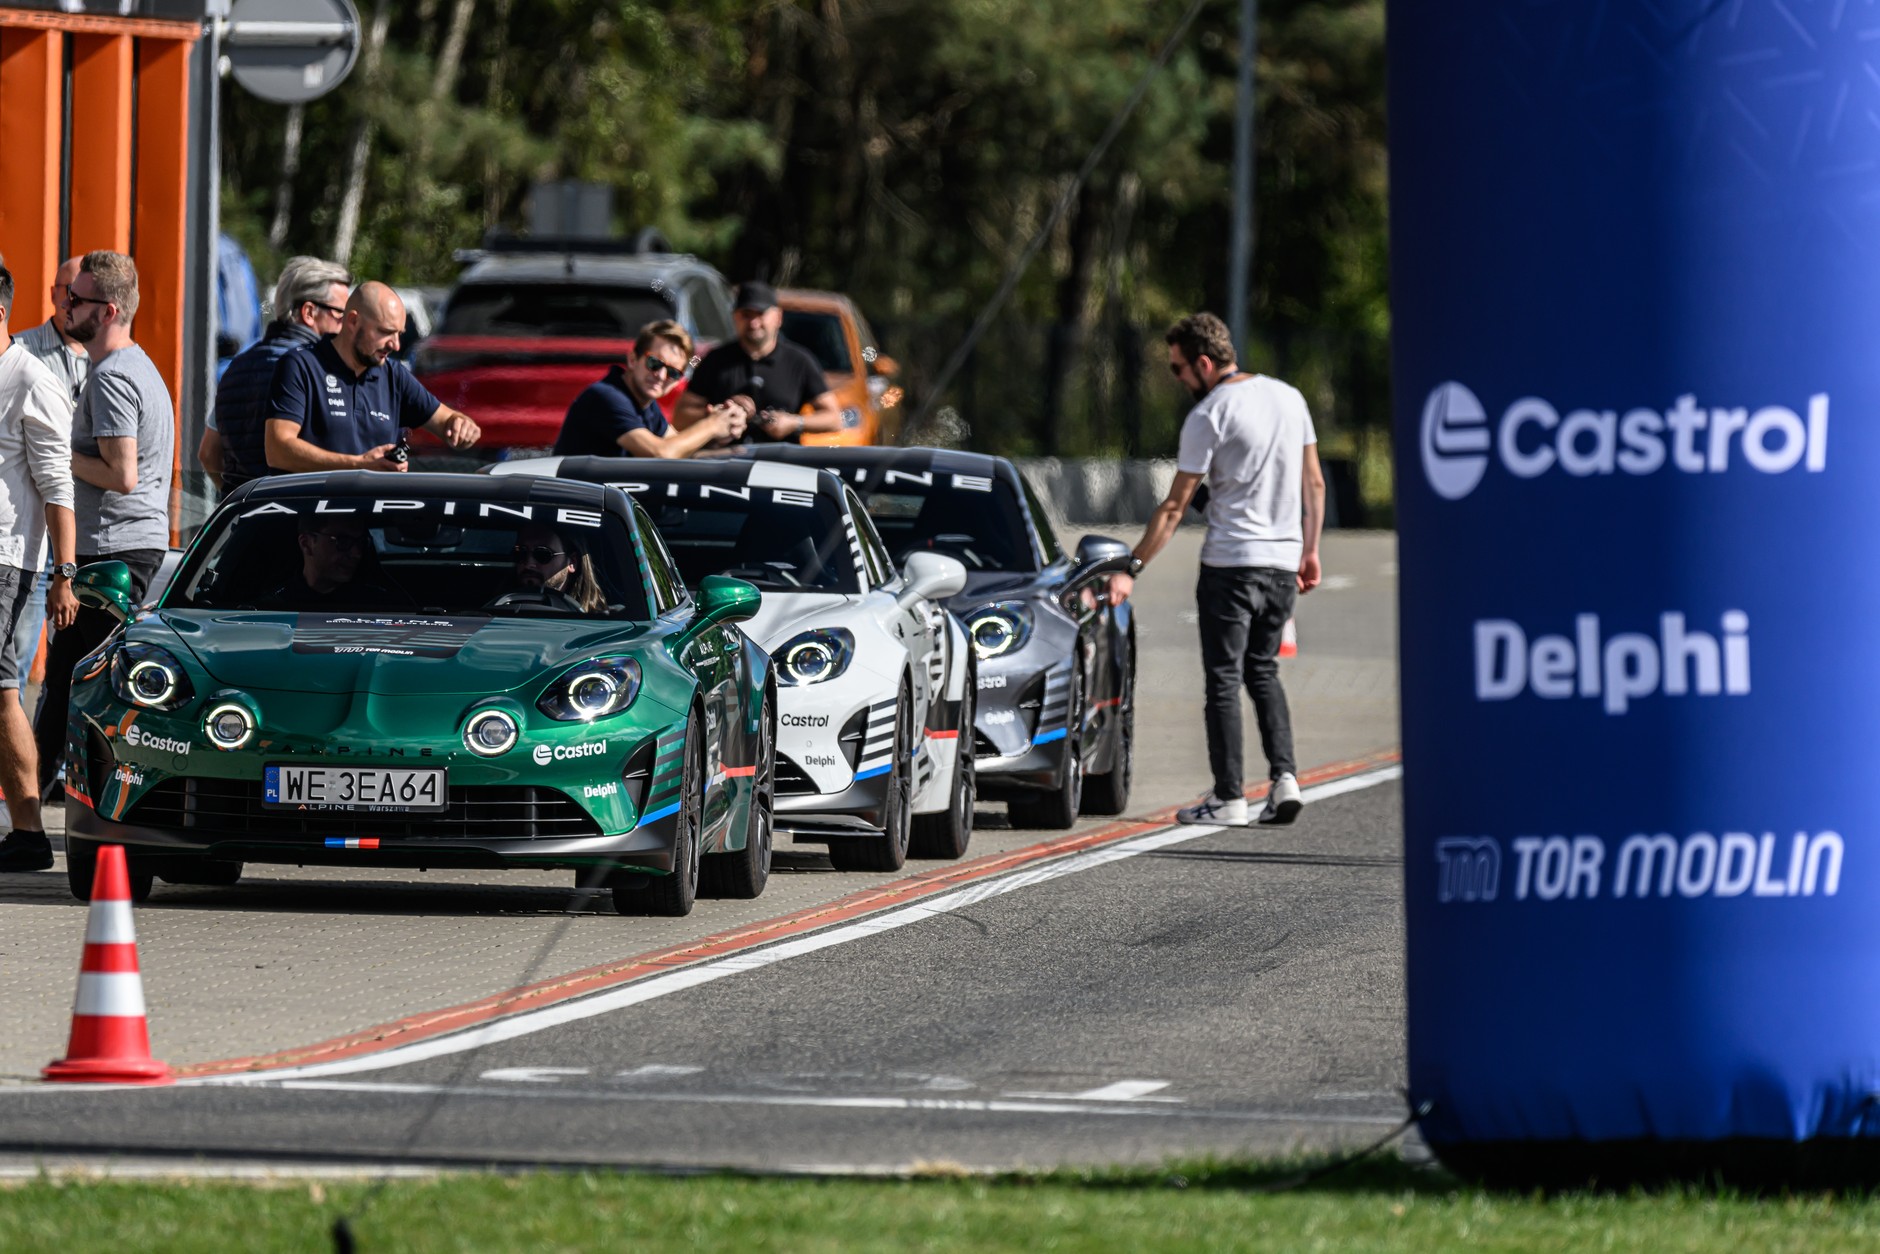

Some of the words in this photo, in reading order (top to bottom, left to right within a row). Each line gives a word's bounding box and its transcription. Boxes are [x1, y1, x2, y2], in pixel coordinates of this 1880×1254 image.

[1498, 393, 1829, 478] Castrol
[240, 500, 602, 528] ALPINE
[1473, 609, 1751, 715] Delphi
[780, 713, 830, 727] Castrol
[141, 732, 191, 755] Castrol
[554, 739, 607, 760] Castrol
[805, 755, 836, 768] Delphi
[115, 769, 144, 786] Delphi
[286, 770, 327, 801] WE
[339, 771, 437, 803] 3EA64
[266, 788, 278, 798] PL
[583, 781, 618, 798] Delphi
[1512, 837, 1605, 900] TOR
[1612, 831, 1845, 899] MODLIN
